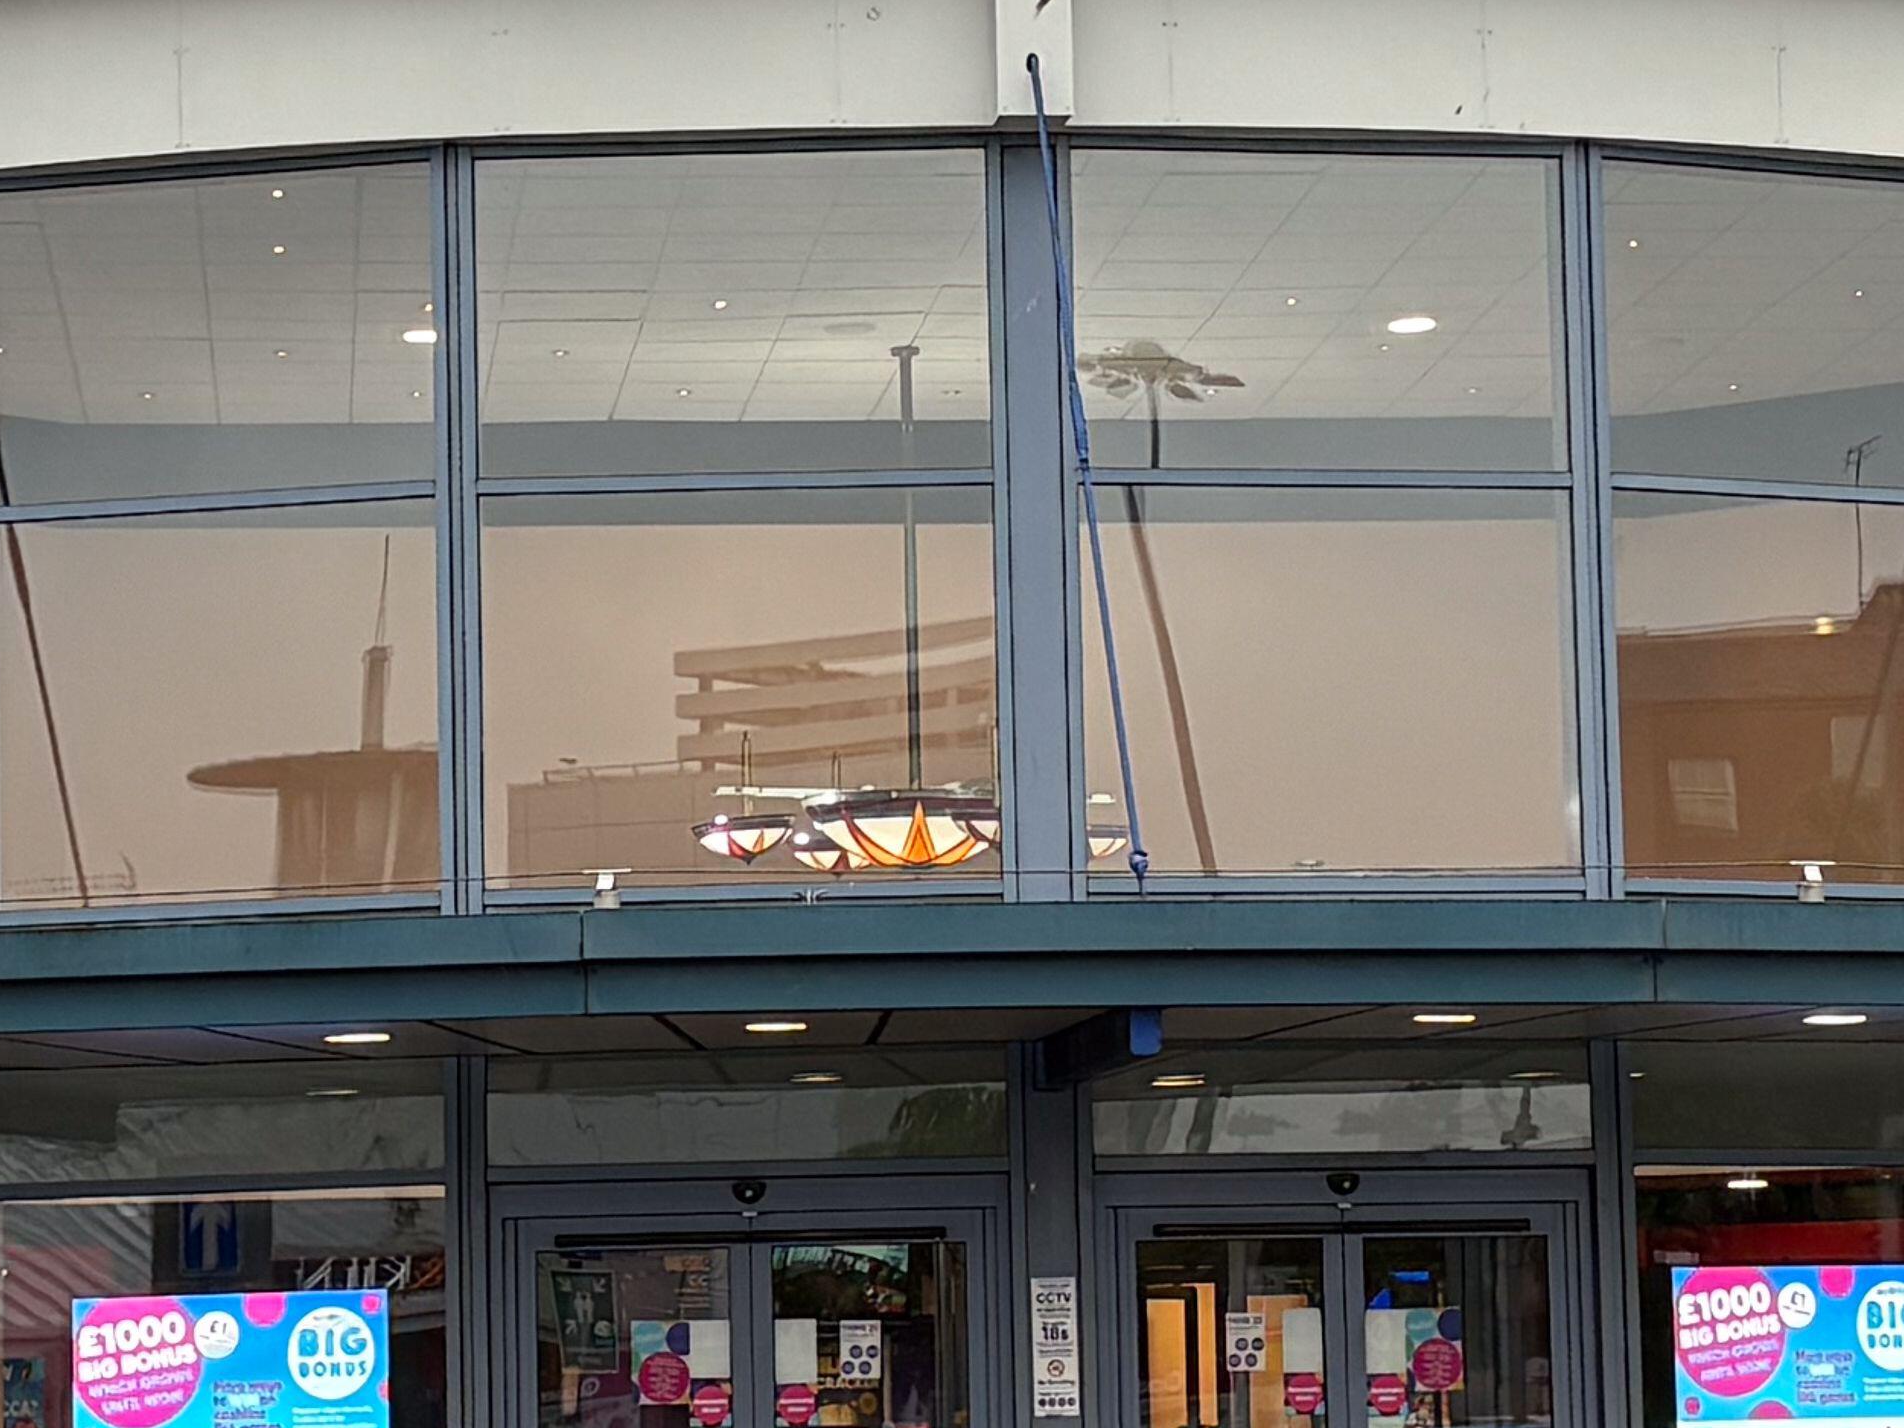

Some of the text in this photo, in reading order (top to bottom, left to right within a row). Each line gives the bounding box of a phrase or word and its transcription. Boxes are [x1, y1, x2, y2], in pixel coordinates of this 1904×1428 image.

[1036, 1291, 1072, 1304] CCTV
[1679, 1282, 1772, 1325] £1000
[78, 1311, 186, 1358] £1000
[298, 1327, 367, 1357] BIG
[1679, 1314, 1781, 1350] BIG BONUS
[298, 1360, 367, 1378] BONUS
